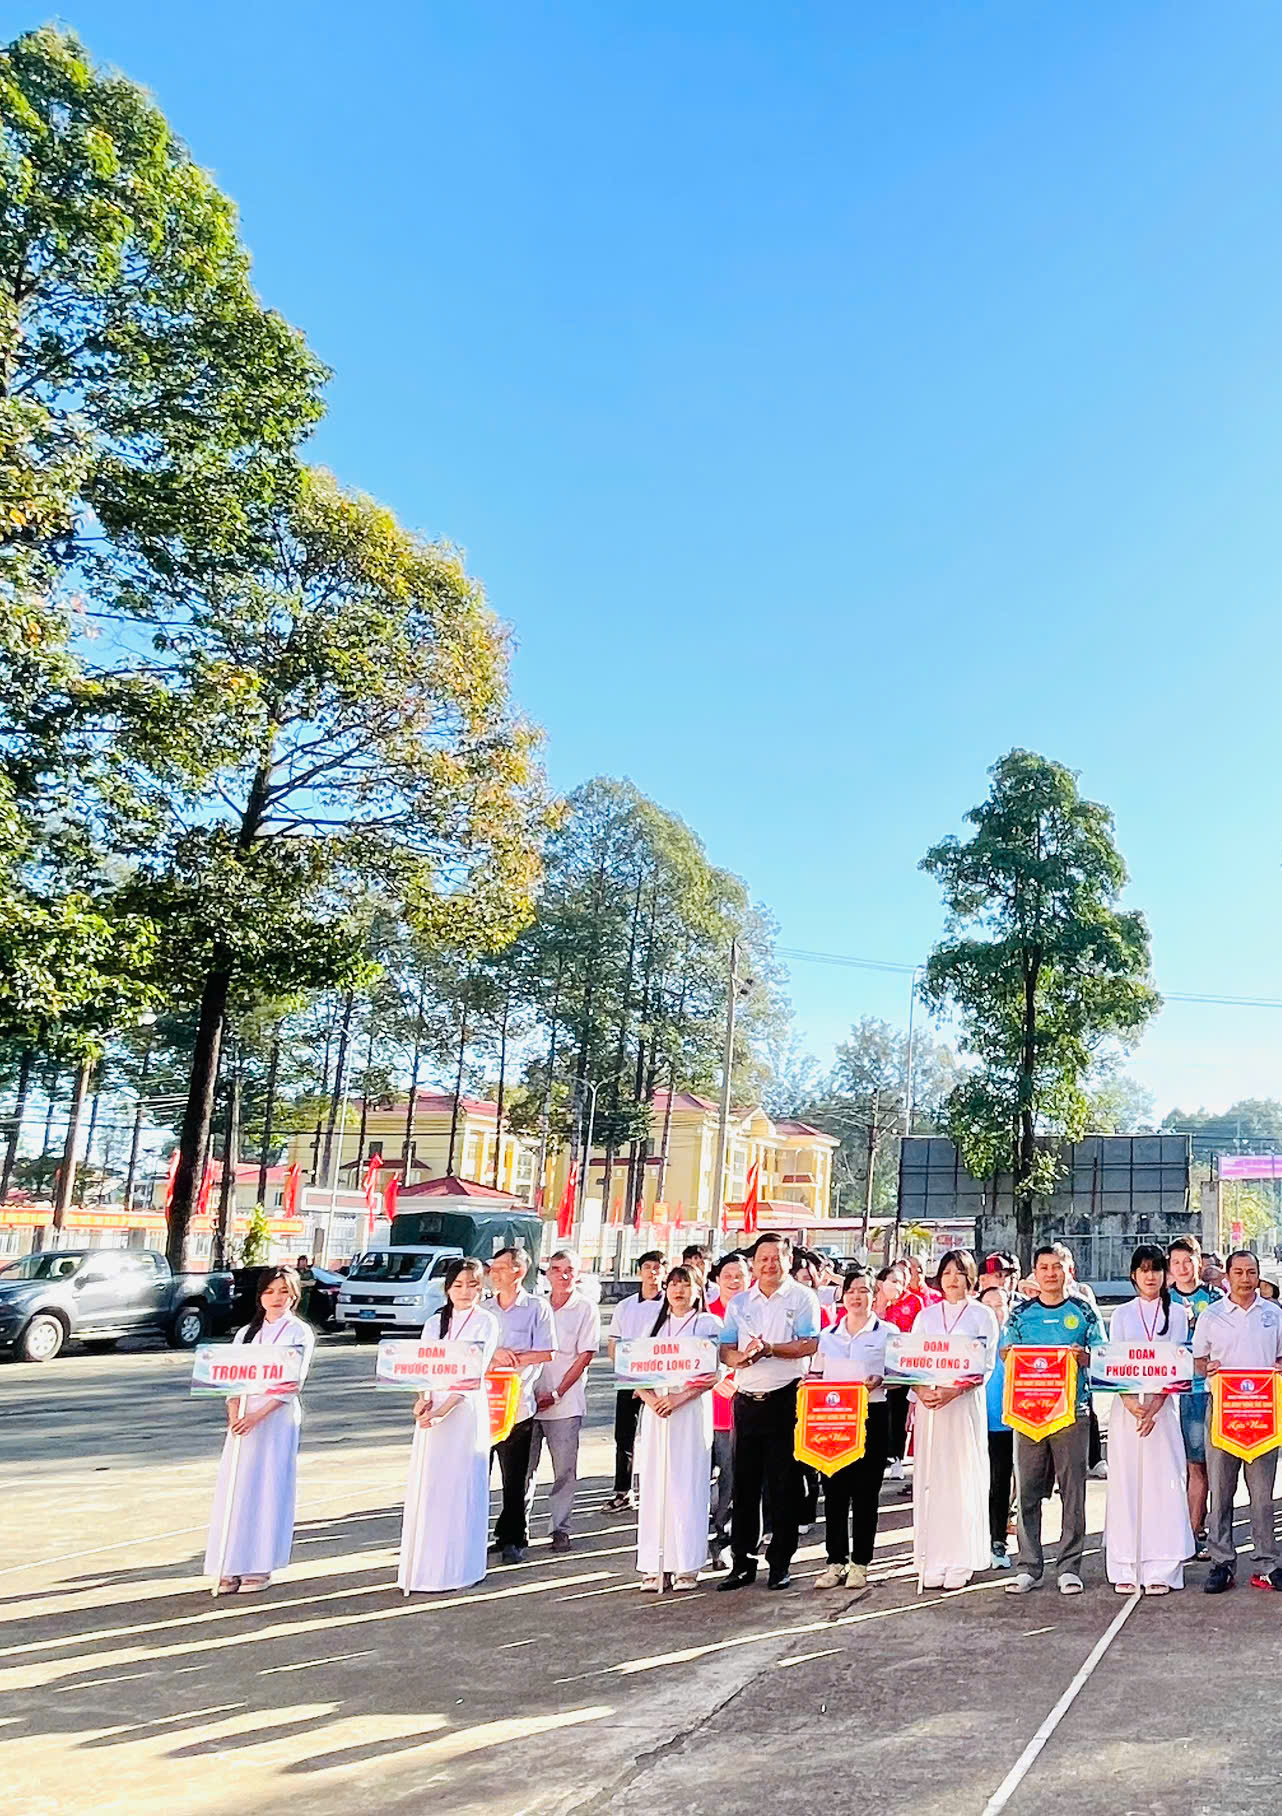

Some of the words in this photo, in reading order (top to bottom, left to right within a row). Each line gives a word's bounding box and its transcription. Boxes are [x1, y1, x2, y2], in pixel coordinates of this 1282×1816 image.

[667, 1360, 691, 1370] LONG
[936, 1359, 960, 1369] LONG
[432, 1364, 458, 1375] LONG
[1142, 1366, 1168, 1376] LONG
